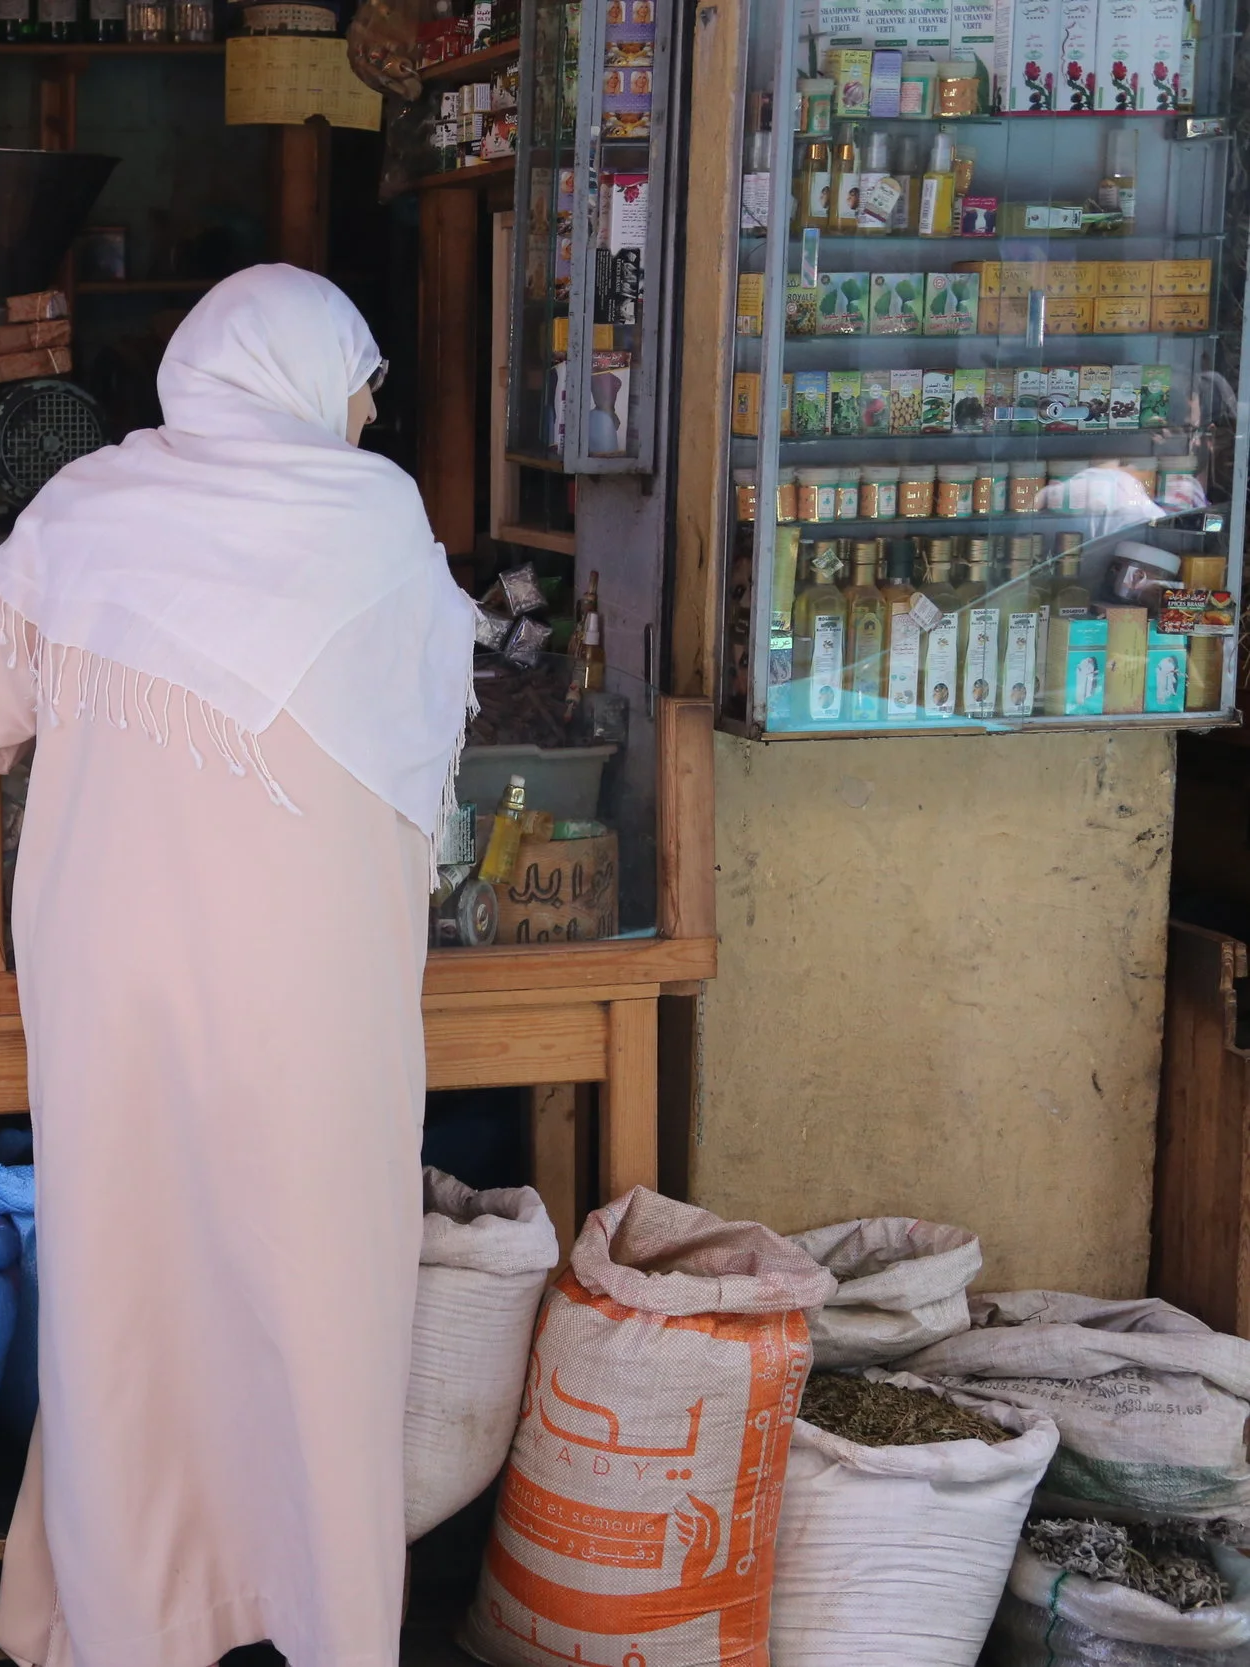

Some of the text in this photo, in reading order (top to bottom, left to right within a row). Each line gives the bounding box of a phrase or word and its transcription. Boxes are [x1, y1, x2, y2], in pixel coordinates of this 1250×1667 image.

[820, 7, 861, 15] SHAMPOOING
[865, 8, 907, 17] SHAMPOOING
[908, 8, 949, 16] SHAMPOOING
[953, 5, 994, 13] SHAMPOOING
[821, 15, 860, 24] AU CHANVRE
[875, 17, 906, 25] CHANVRE
[916, 16, 948, 24] CHANVRE
[961, 13, 993, 21] CHANVRE
[918, 25, 938, 33] VERTE
[962, 22, 982, 30] VERTE
[1086, 1382, 1152, 1399] TANGER
[546, 1502, 564, 1520] et
[572, 1509, 656, 1535] semoule
